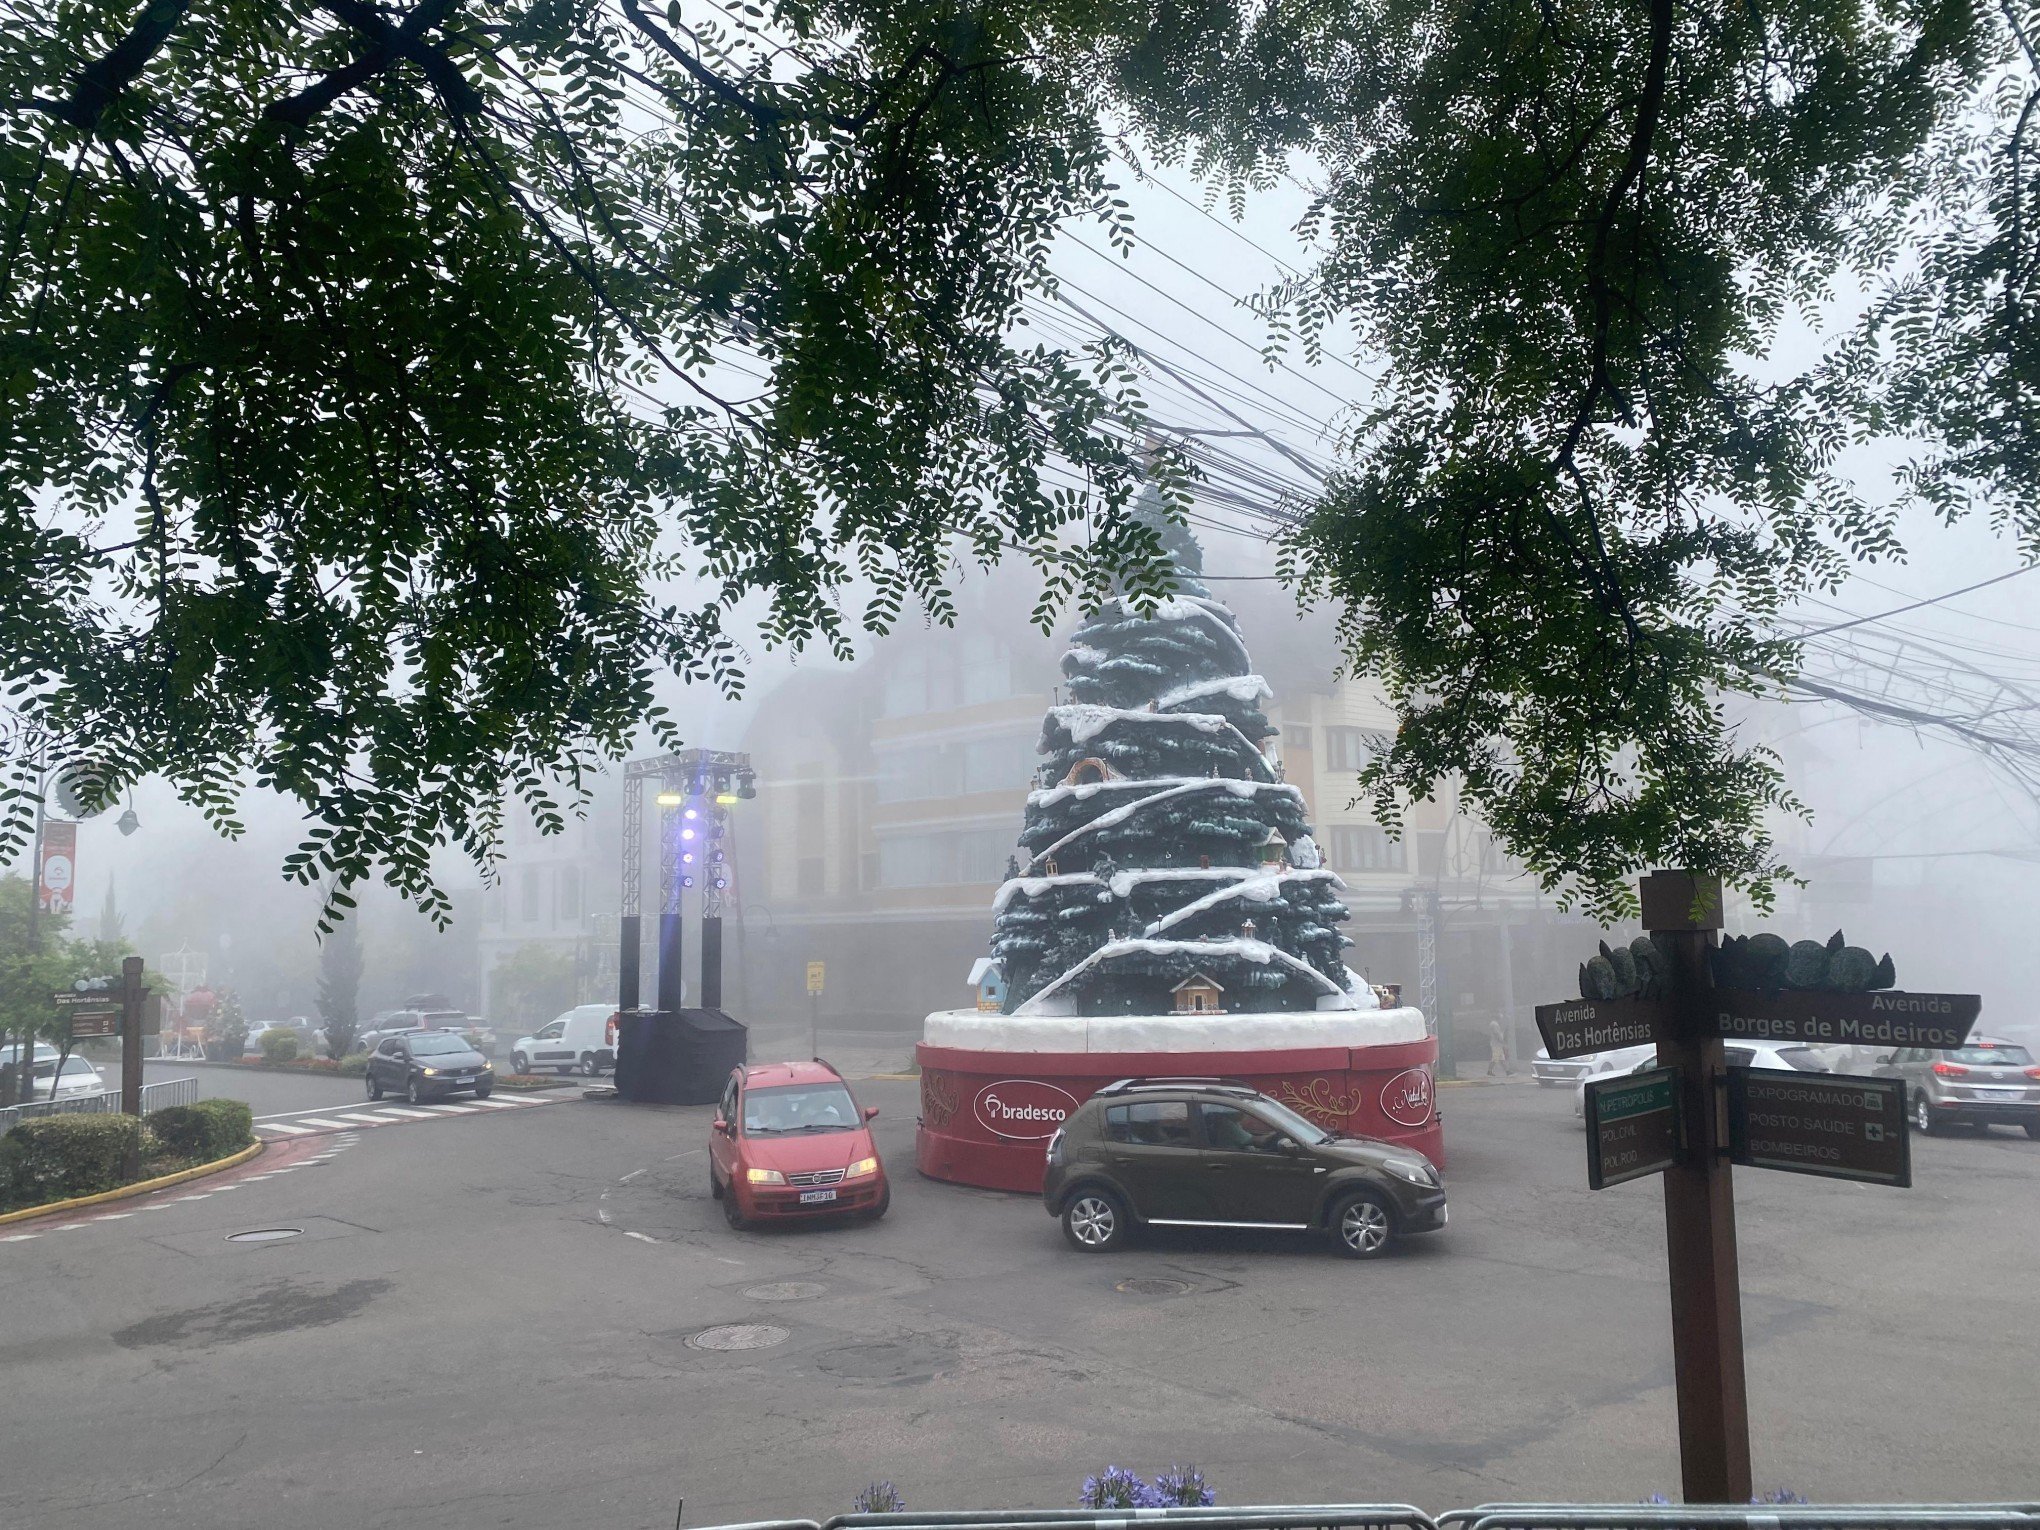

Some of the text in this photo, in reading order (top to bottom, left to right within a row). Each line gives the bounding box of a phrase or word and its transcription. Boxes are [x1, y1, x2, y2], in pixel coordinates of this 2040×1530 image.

[1555, 1004, 1596, 1024] Avenida
[1872, 995, 1952, 1014] Avenida
[1556, 1021, 1652, 1051] Das Hortênsias
[1718, 1013, 1958, 1045] Borges de Medeiros
[1747, 1086, 1864, 1107] EXPOGRAMADO
[1002, 1102, 1066, 1122] bradesco
[1748, 1113, 1857, 1135] POSTO SAÚDE
[1750, 1139, 1841, 1160] BOMBEIROS
